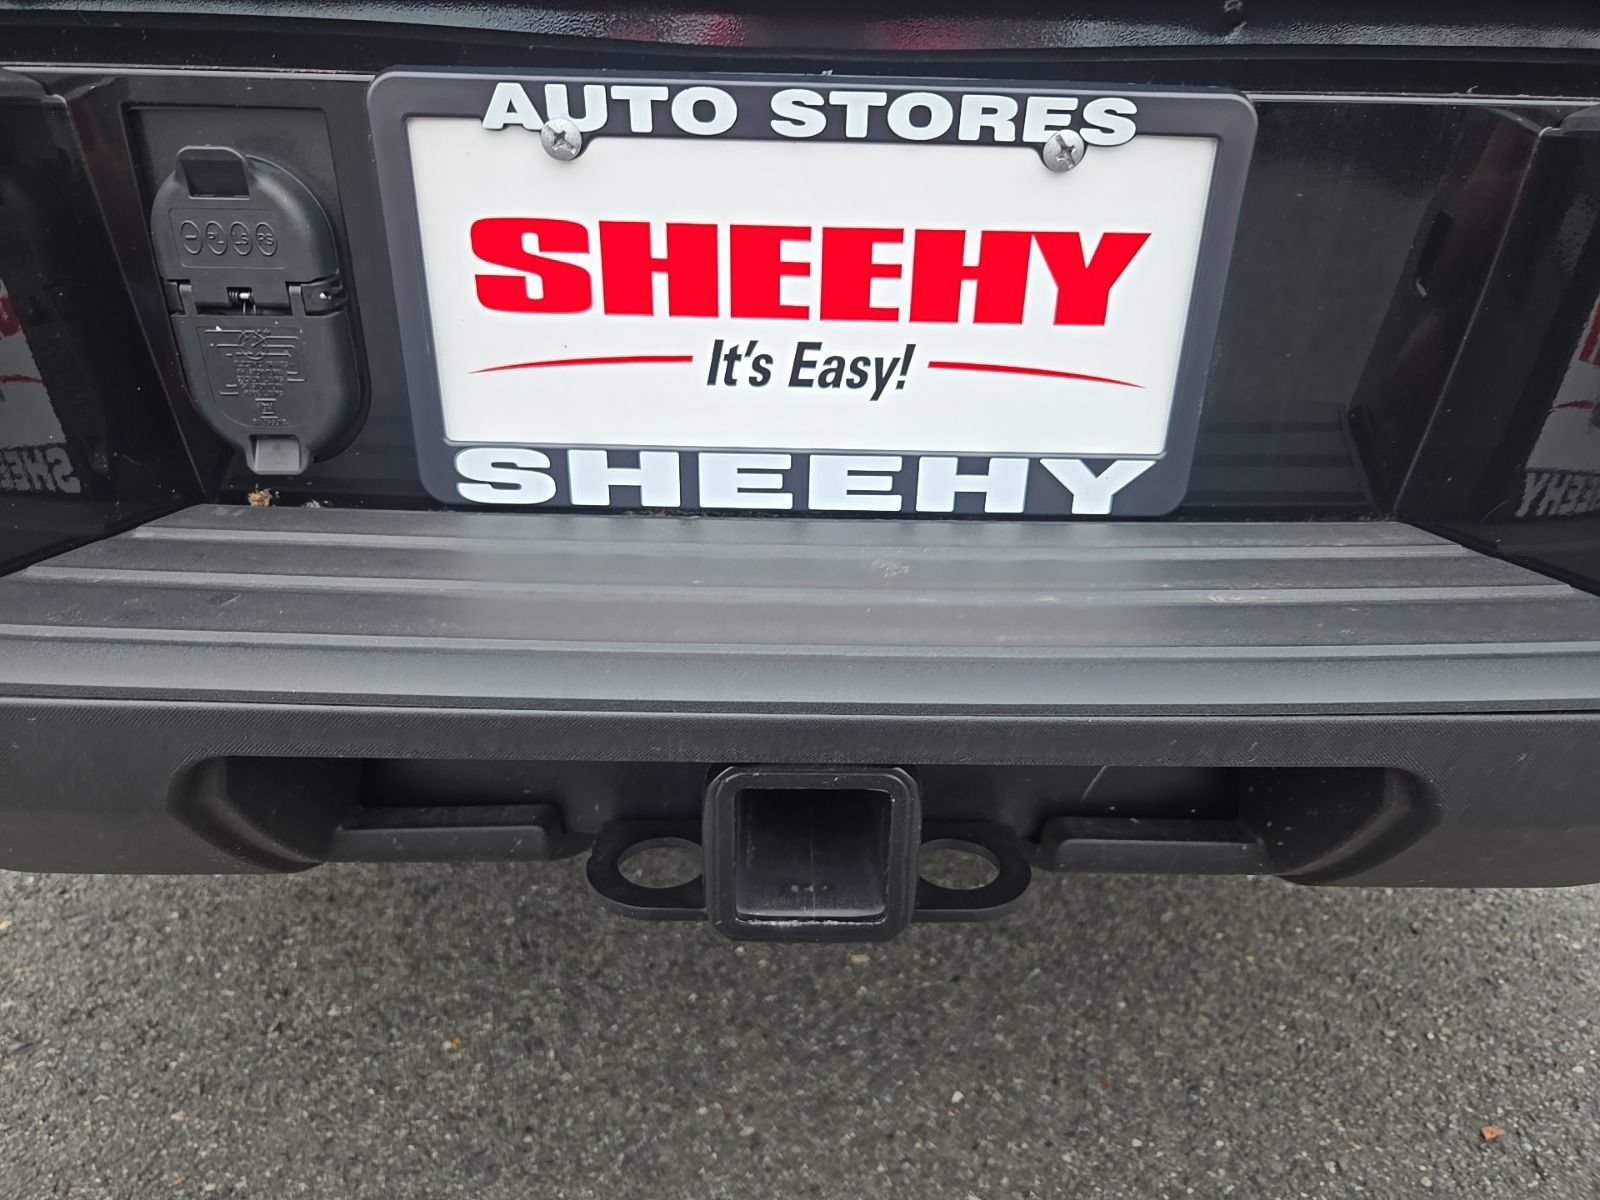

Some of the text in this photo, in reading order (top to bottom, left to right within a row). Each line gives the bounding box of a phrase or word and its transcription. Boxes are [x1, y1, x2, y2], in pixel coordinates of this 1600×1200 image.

[482, 82, 1138, 146] AUTO STORES
[470, 217, 1152, 326] SHEEHY
[788, 341, 917, 402] Easy!
[454, 447, 1155, 515] SHEEHY
